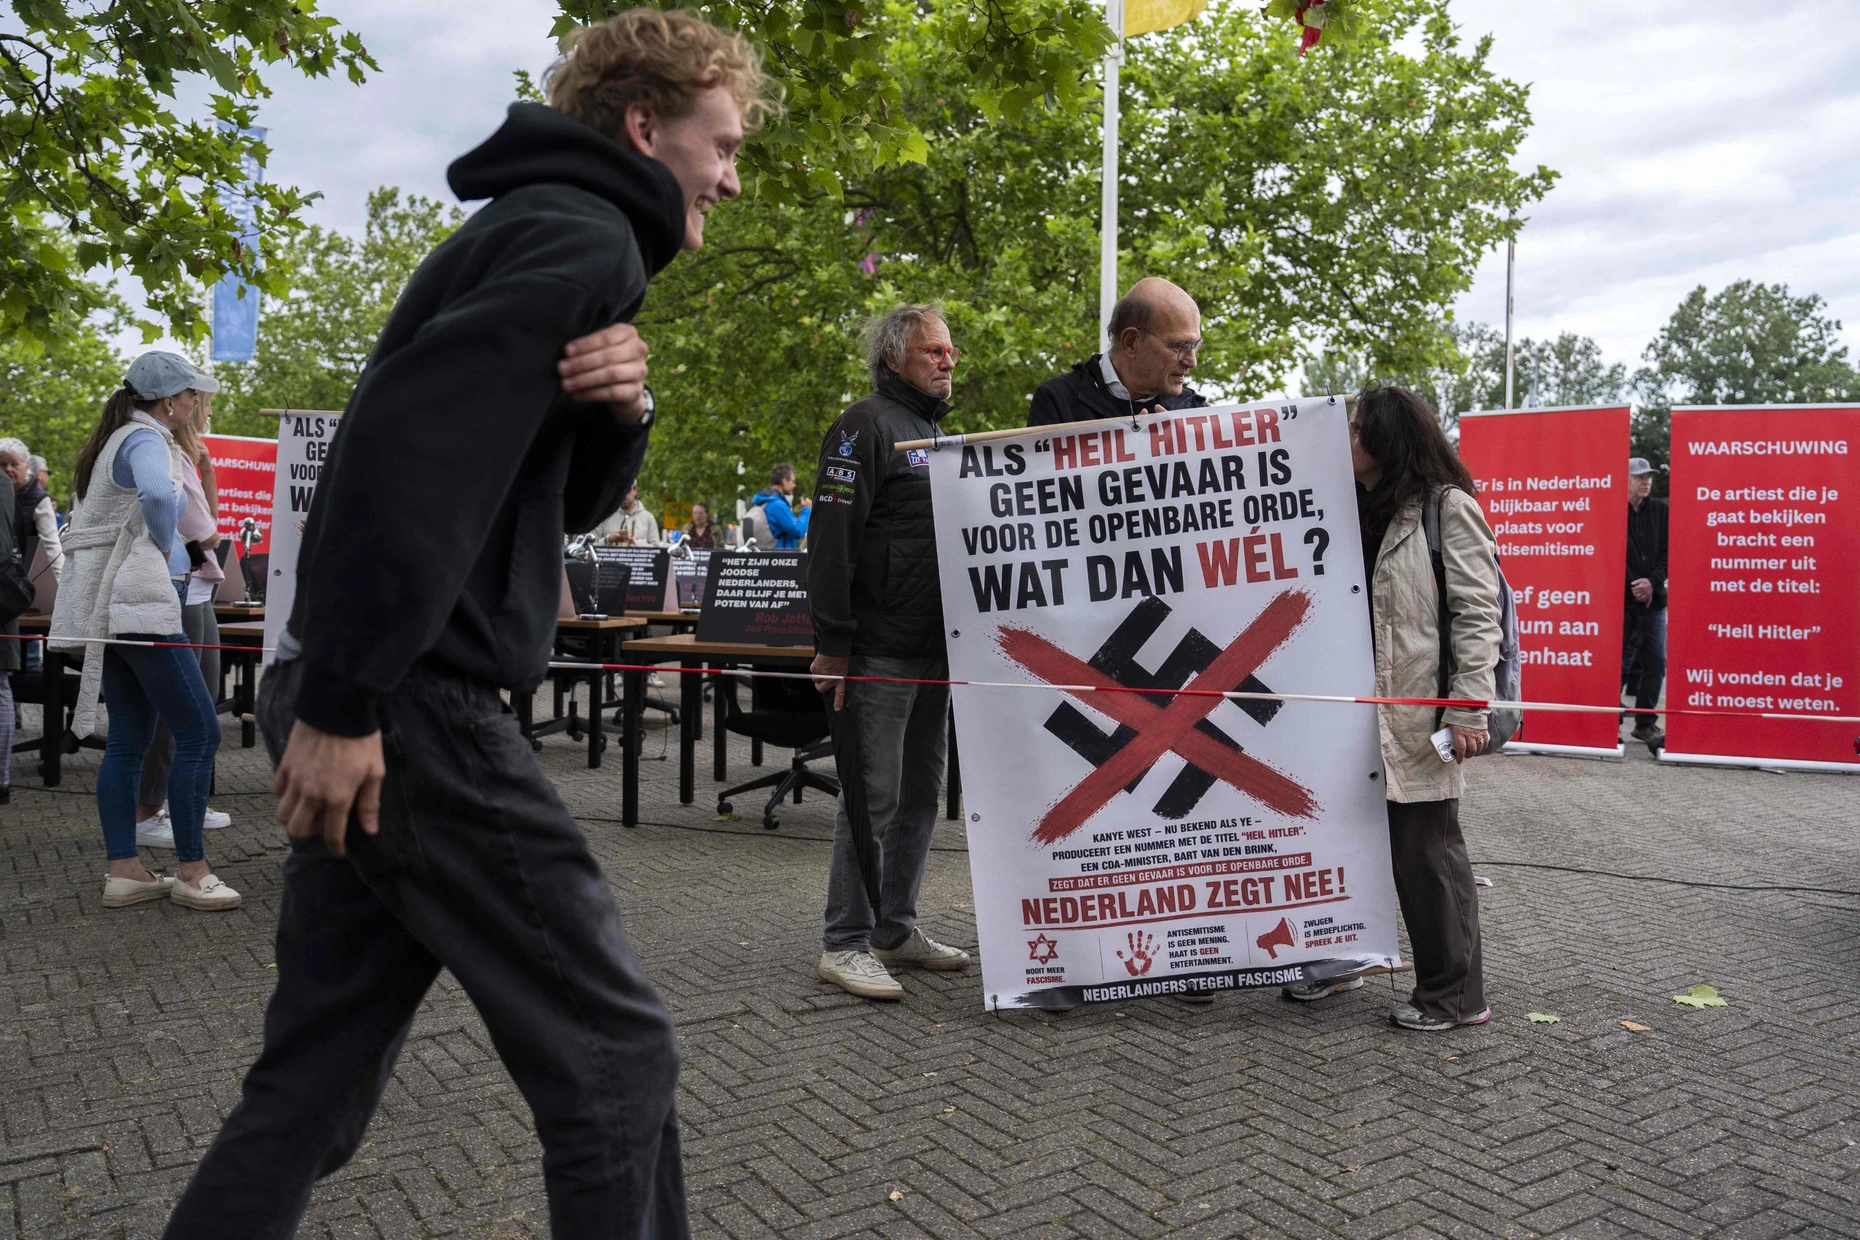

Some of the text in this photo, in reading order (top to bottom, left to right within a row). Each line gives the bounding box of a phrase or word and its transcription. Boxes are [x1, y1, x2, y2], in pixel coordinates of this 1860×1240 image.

[293, 417, 325, 438] ALS
[959, 443, 1026, 479] ALS
[1034, 429, 1136, 470] “HEIL
[1148, 405, 1298, 457] HITLER”
[1688, 440, 1848, 456] WAARSCHUWING
[306, 441, 331, 462] GE
[211, 458, 276, 472] AARSCHUWI
[990, 448, 1292, 517] GEEN GEVAAR IS
[1474, 474, 1612, 492] Er is in Nederland
[218, 488, 272, 500] artiest die
[1696, 486, 1838, 504] De artiest die je
[218, 503, 230, 511] at
[1490, 498, 1590, 516] blijkbaar wél
[961, 489, 1324, 555] VOOR DE OPENBARE ORDE,
[1706, 509, 1826, 526] gaat bekijken
[1494, 521, 1584, 536] plaats voor
[1717, 532, 1814, 547] bracht een
[771, 558, 798, 566] ONZE
[1710, 556, 1816, 570] nummer uit
[720, 568, 760, 576] JOODSE
[968, 558, 1068, 613] WAT
[1086, 546, 1184, 602] DAN
[718, 579, 798, 590] NEDERLANDERS,
[1710, 578, 1820, 594] met de titel:
[1514, 586, 1590, 608] ef geen
[756, 612, 812, 624] Rob Jette
[1559, 621, 1599, 636] aan
[1708, 623, 1820, 640] “Heil Hitler”
[1519, 647, 1592, 666] enhaat
[1686, 669, 1842, 692] Wij vonden dat je
[1688, 692, 1841, 712] dit moest weten.
[1093, 830, 1124, 843] KANYE
[1126, 828, 1152, 840] WEST
[1165, 825, 1178, 834] NU
[1180, 821, 1217, 832] BEKEND
[1220, 818, 1238, 828] ALS
[1240, 817, 1252, 826] YE
[1052, 826, 1306, 860] PRODUCEERT EEN NUMMER MET DE TITEL “HEIL HITLER”.
[1081, 844, 1278, 872] EEN CDA-MINISTER, BART VAN DEN BRINK,
[1052, 856, 1308, 890] ZEGT DAT ER GEEN GEVAAR IS VOOR DE OPENBARE ORDE.
[1022, 884, 1196, 925] NEDERLAND
[1206, 876, 1274, 908] ZEGT
[1304, 917, 1333, 928] ZWIJGEN
[1314, 923, 1366, 937] MEDEPLICHTIG.
[1167, 925, 1225, 938] ANTISEMITISME
[1178, 938, 1196, 948] GEEN
[1198, 935, 1230, 945] MENING.
[1305, 934, 1358, 949] SPREEK JE UIT.
[1169, 947, 1219, 958] HAAT IS GEEN
[1170, 956, 1234, 969] ENTERTAINMENT.
[1026, 975, 1066, 984] FASCISME.
[1083, 967, 1304, 1002] NEDERLANDERS TEGEN FASCISME
